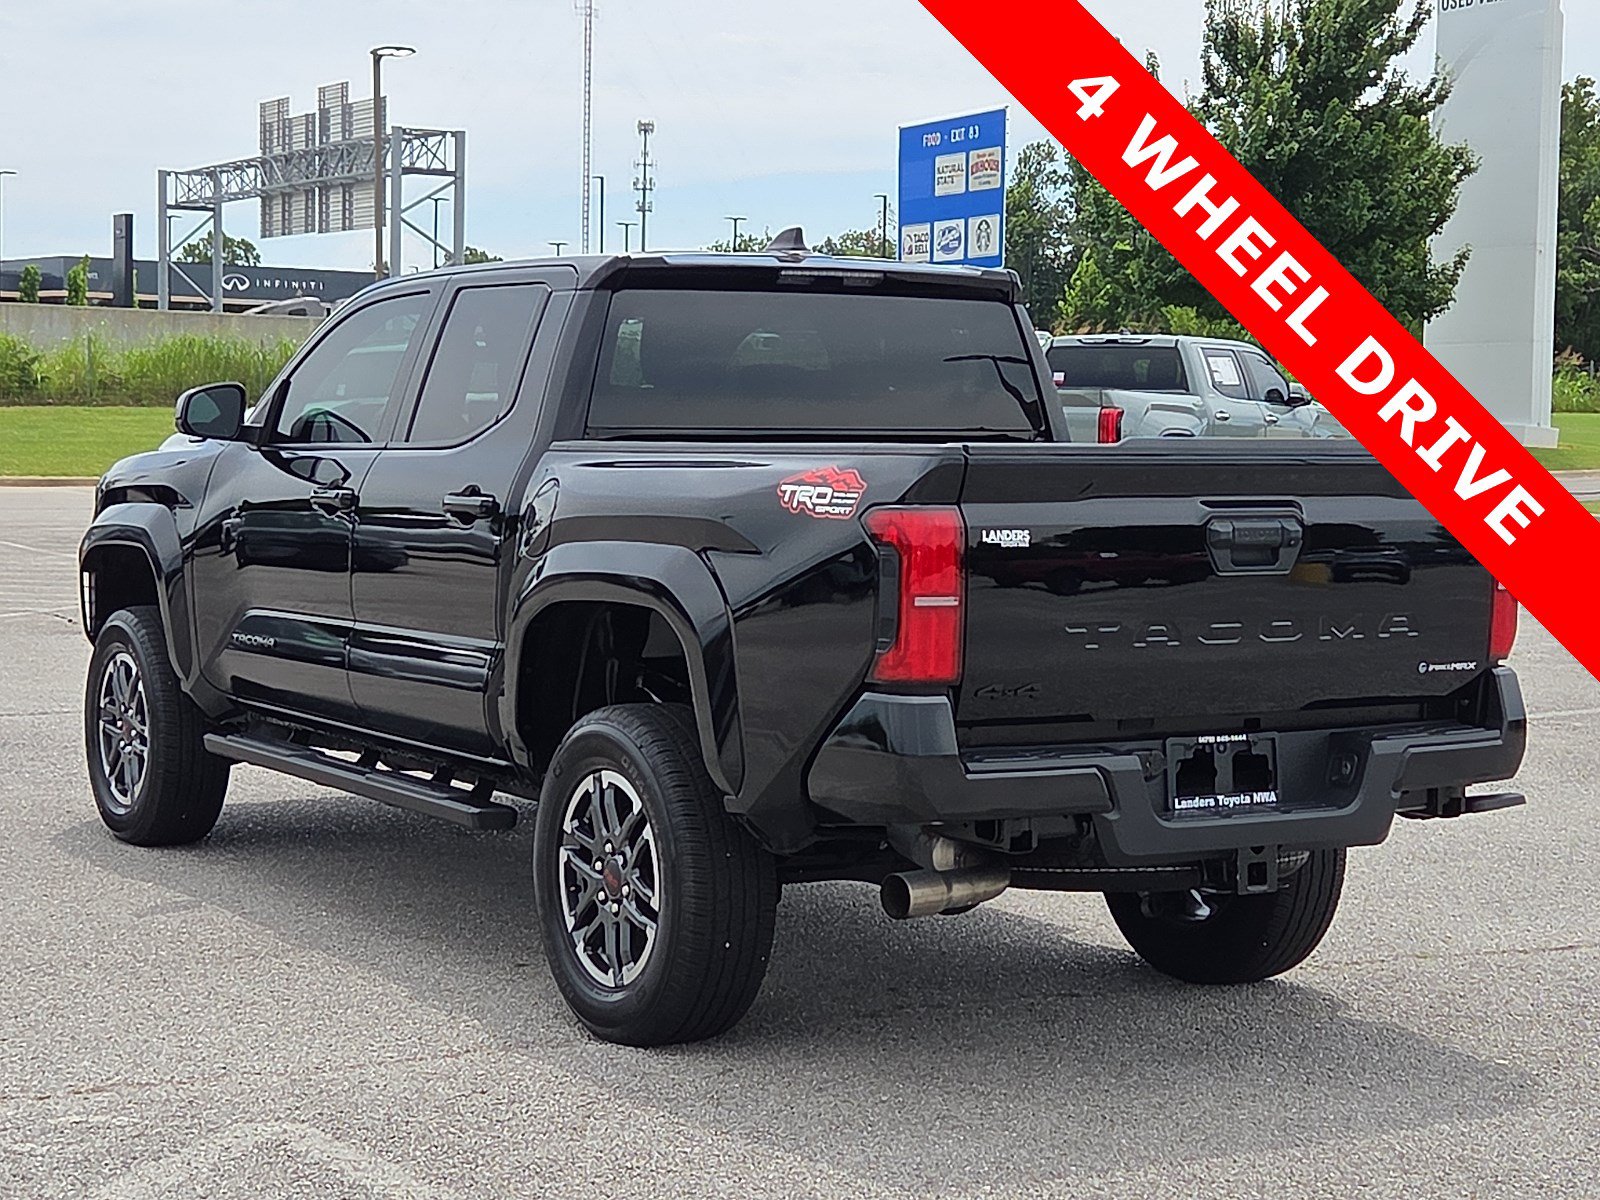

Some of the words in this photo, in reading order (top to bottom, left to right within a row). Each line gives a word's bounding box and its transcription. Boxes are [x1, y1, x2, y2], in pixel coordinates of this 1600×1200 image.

[923, 132, 941, 147] FOOD
[951, 128, 965, 142] EXIT
[968, 125, 979, 139] 83
[937, 163, 964, 175] NATURAL
[937, 176, 954, 186] STATE
[914, 232, 929, 243] TACO
[914, 243, 929, 255] BELL
[255, 278, 324, 291] INFINITI
[814, 505, 853, 515] SPORT
[981, 529, 1031, 543] LANDERS
[1065, 612, 1420, 650] TACOMA
[231, 632, 275, 647] TACOMA
[1174, 796, 1215, 810] Landers
[1216, 794, 1251, 808] Toyota
[1252, 790, 1277, 803] NWA
